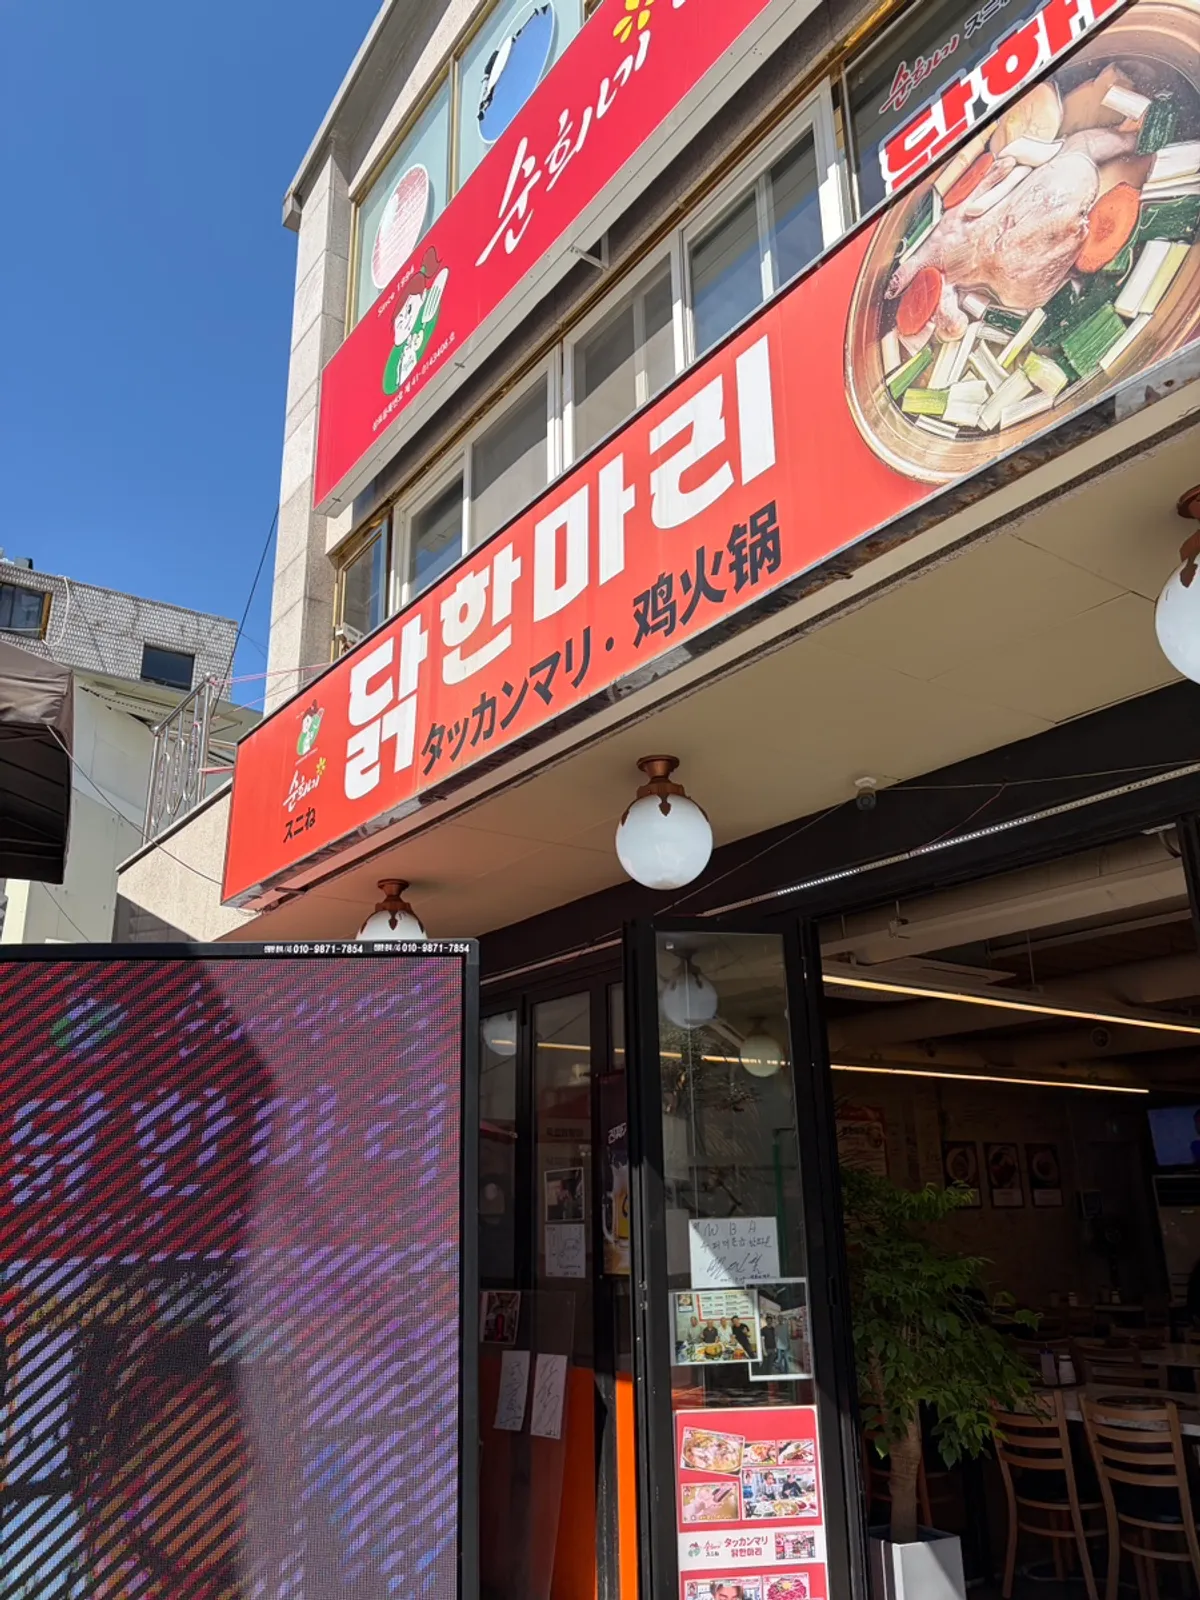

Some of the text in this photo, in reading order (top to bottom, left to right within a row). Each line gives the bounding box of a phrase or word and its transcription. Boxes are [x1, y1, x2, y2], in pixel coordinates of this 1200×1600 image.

[345, 333, 777, 800] 닭한마리
[293, 944, 363, 954] 010-9871-7854
[401, 942, 470, 953] 010-9871-7854
